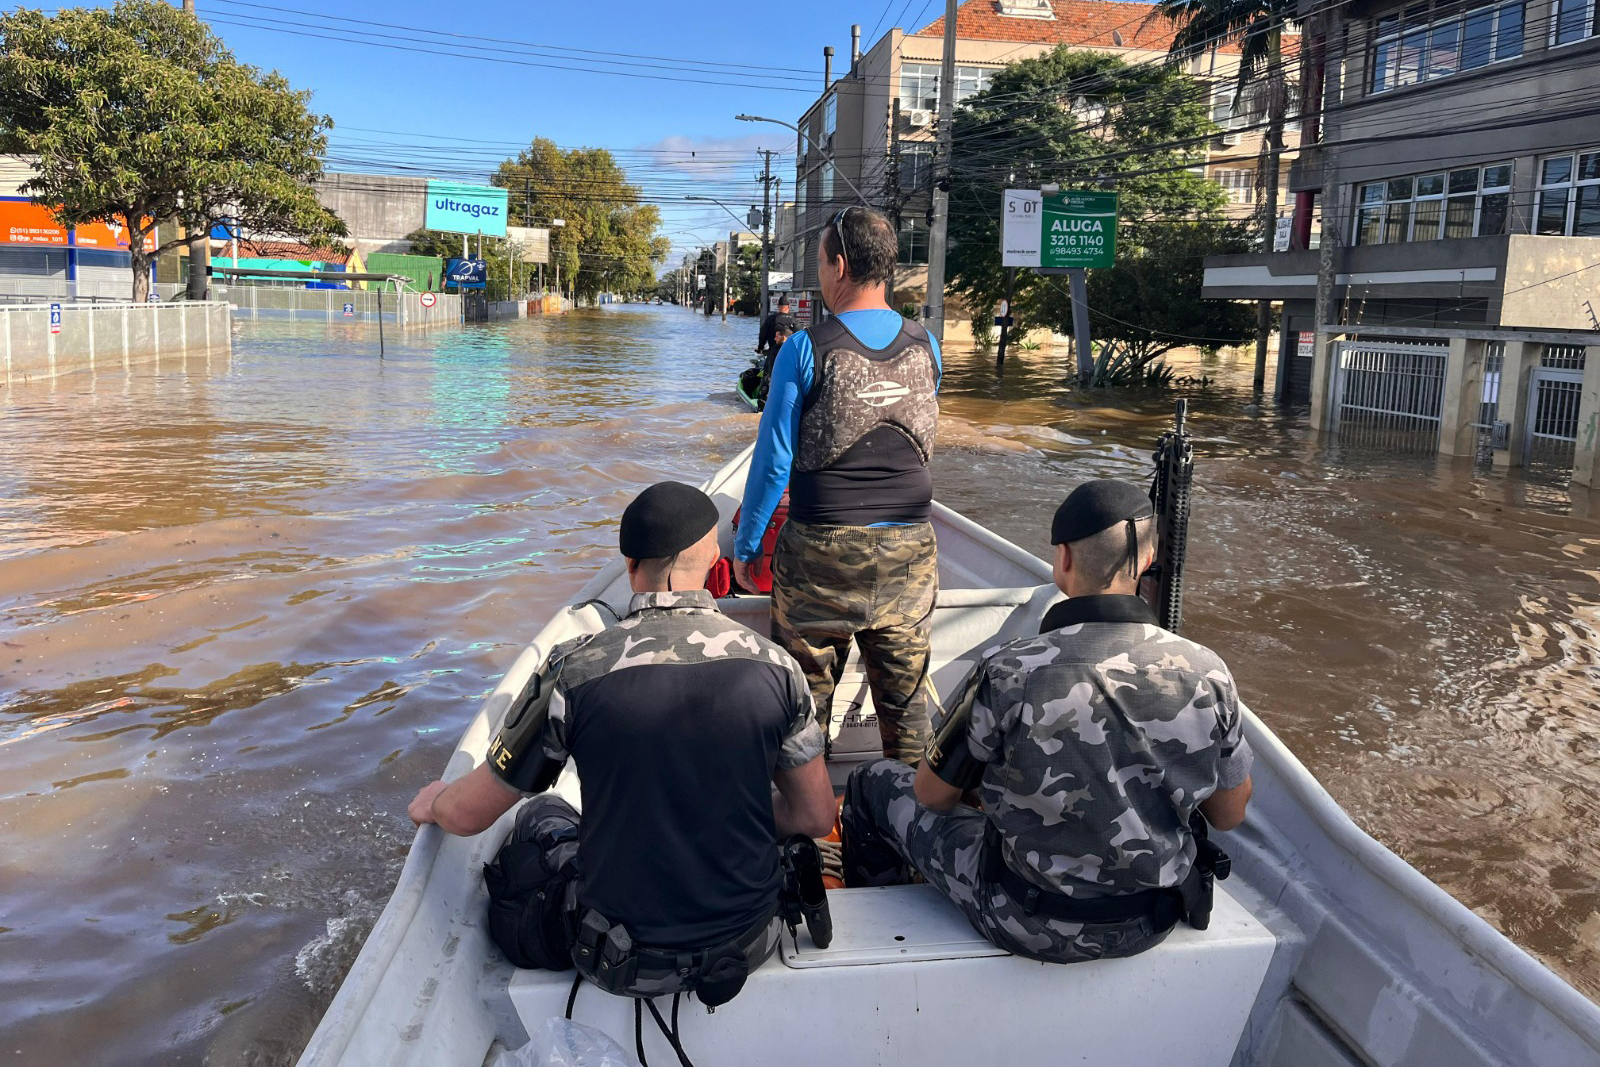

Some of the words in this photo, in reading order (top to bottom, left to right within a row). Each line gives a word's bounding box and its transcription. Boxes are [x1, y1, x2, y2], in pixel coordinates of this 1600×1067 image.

[436, 198, 499, 218] ultragaz
[1009, 201, 1038, 214] SOT
[1051, 219, 1103, 233] ALUGA
[1050, 234, 1077, 246] 3216
[1079, 235, 1104, 246] 1140
[1055, 247, 1082, 255] 98493
[1083, 247, 1104, 255] 4734
[832, 713, 877, 723] CHTS
